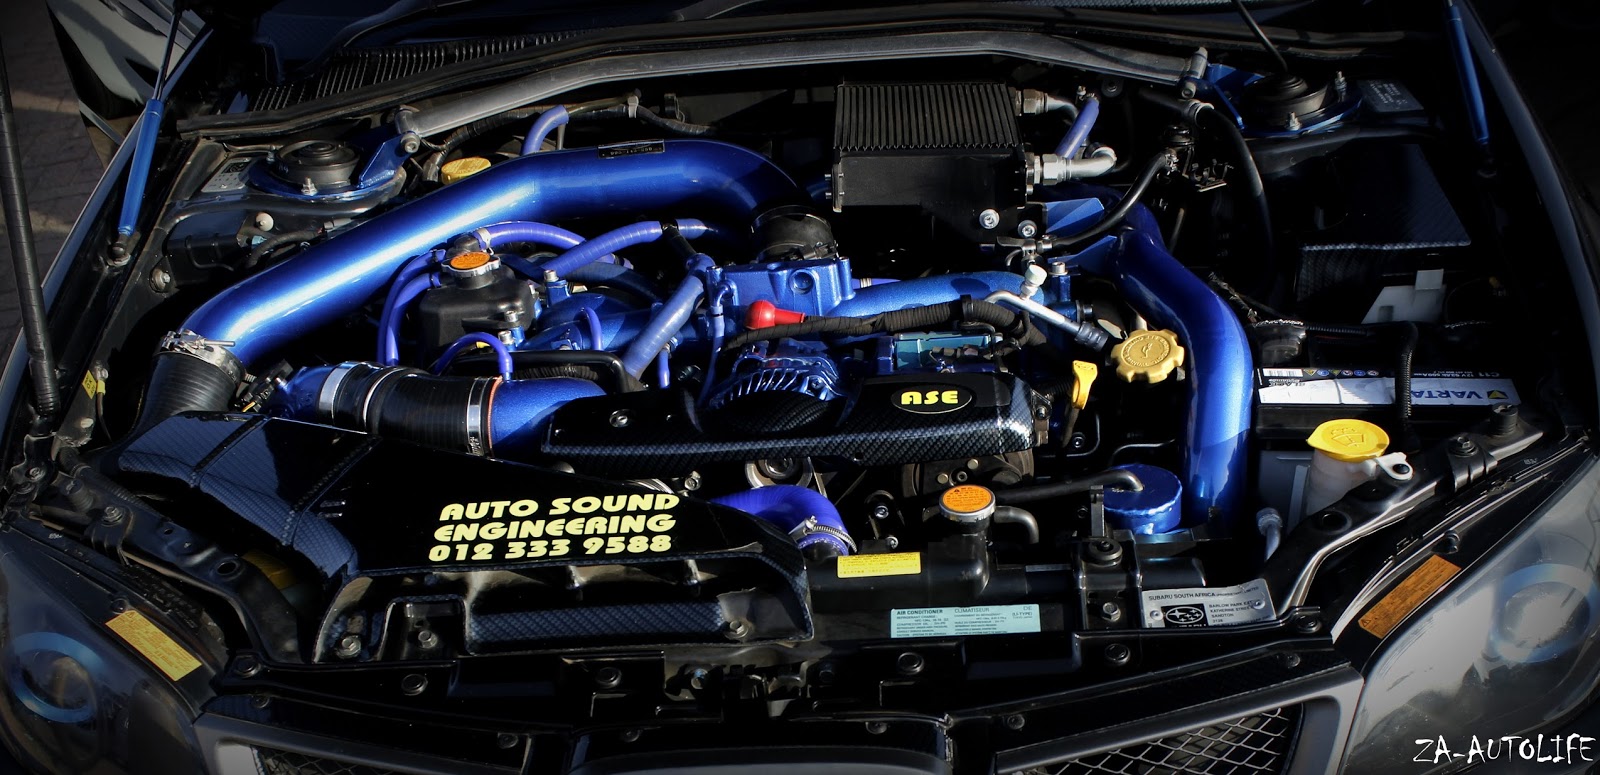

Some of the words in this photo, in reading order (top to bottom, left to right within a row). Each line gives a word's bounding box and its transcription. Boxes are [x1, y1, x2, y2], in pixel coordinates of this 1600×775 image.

[901, 390, 958, 405] ASE
[1411, 390, 1482, 400] VARTA
[439, 499, 539, 520] AUTO
[549, 494, 680, 516] SOUND
[434, 514, 676, 542] ENGINEERING
[428, 543, 494, 562] 012
[505, 539, 571, 559] 333
[583, 535, 671, 554] 9588
